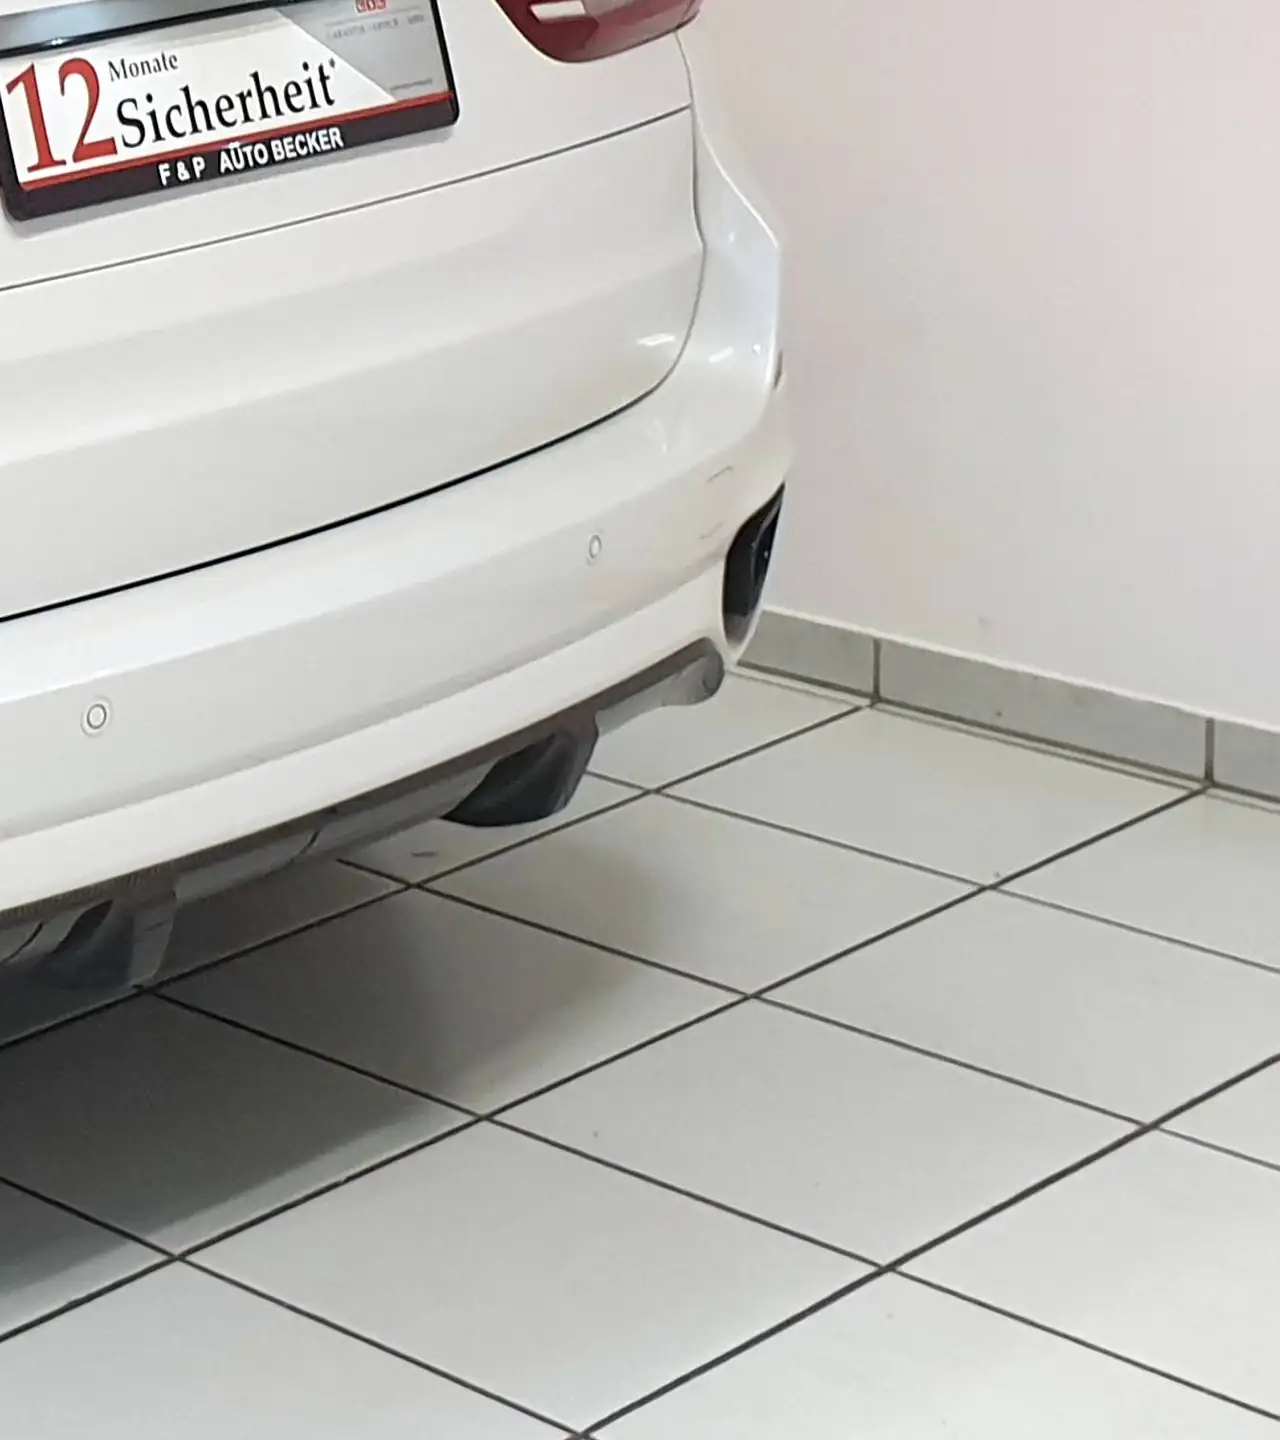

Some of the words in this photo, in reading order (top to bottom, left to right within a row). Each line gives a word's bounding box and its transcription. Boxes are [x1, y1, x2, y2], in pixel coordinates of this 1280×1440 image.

[6, 57, 118, 173] 12
[108, 51, 178, 83] Monate
[271, 126, 344, 161] BECKER
